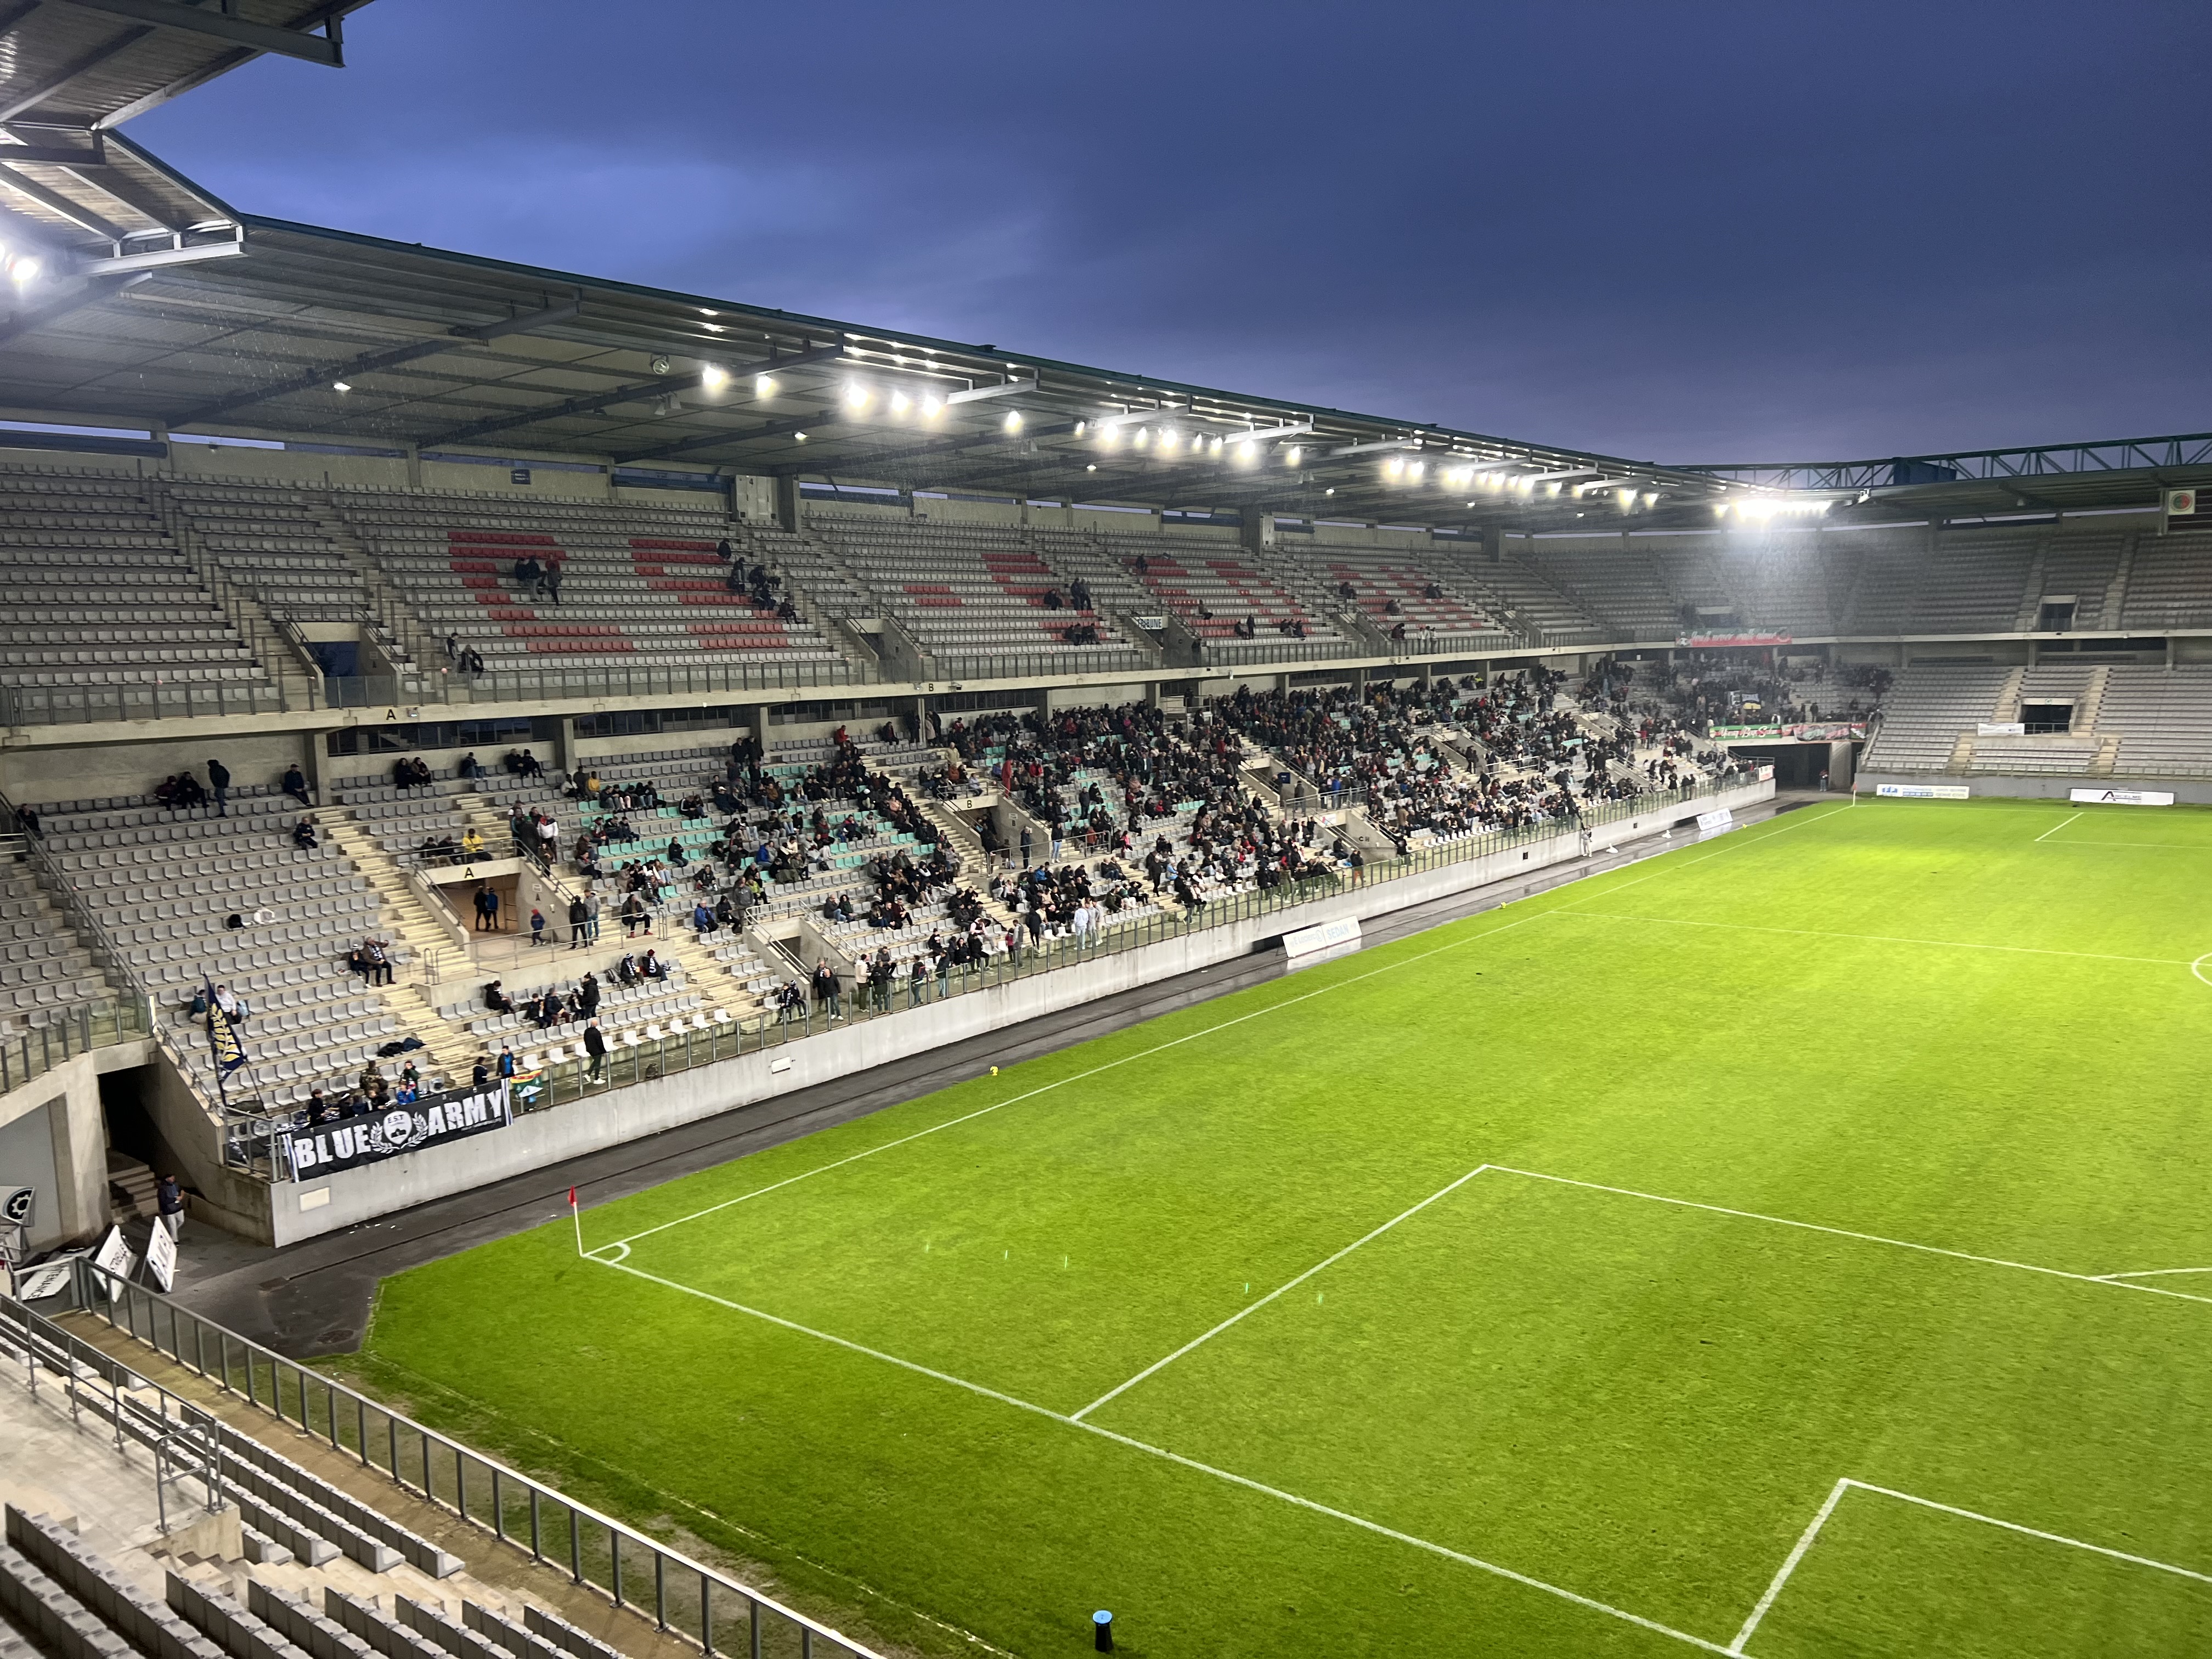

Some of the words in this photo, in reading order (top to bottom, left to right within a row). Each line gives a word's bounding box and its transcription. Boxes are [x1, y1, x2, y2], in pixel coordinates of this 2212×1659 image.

[928, 683, 934, 691] B
[386, 709, 396, 720] A
[967, 800, 972, 808] B
[464, 867, 474, 878] A
[1327, 923, 1349, 940] SEDAN
[294, 1124, 371, 1169] BLUE
[427, 1088, 503, 1136] ARMY
